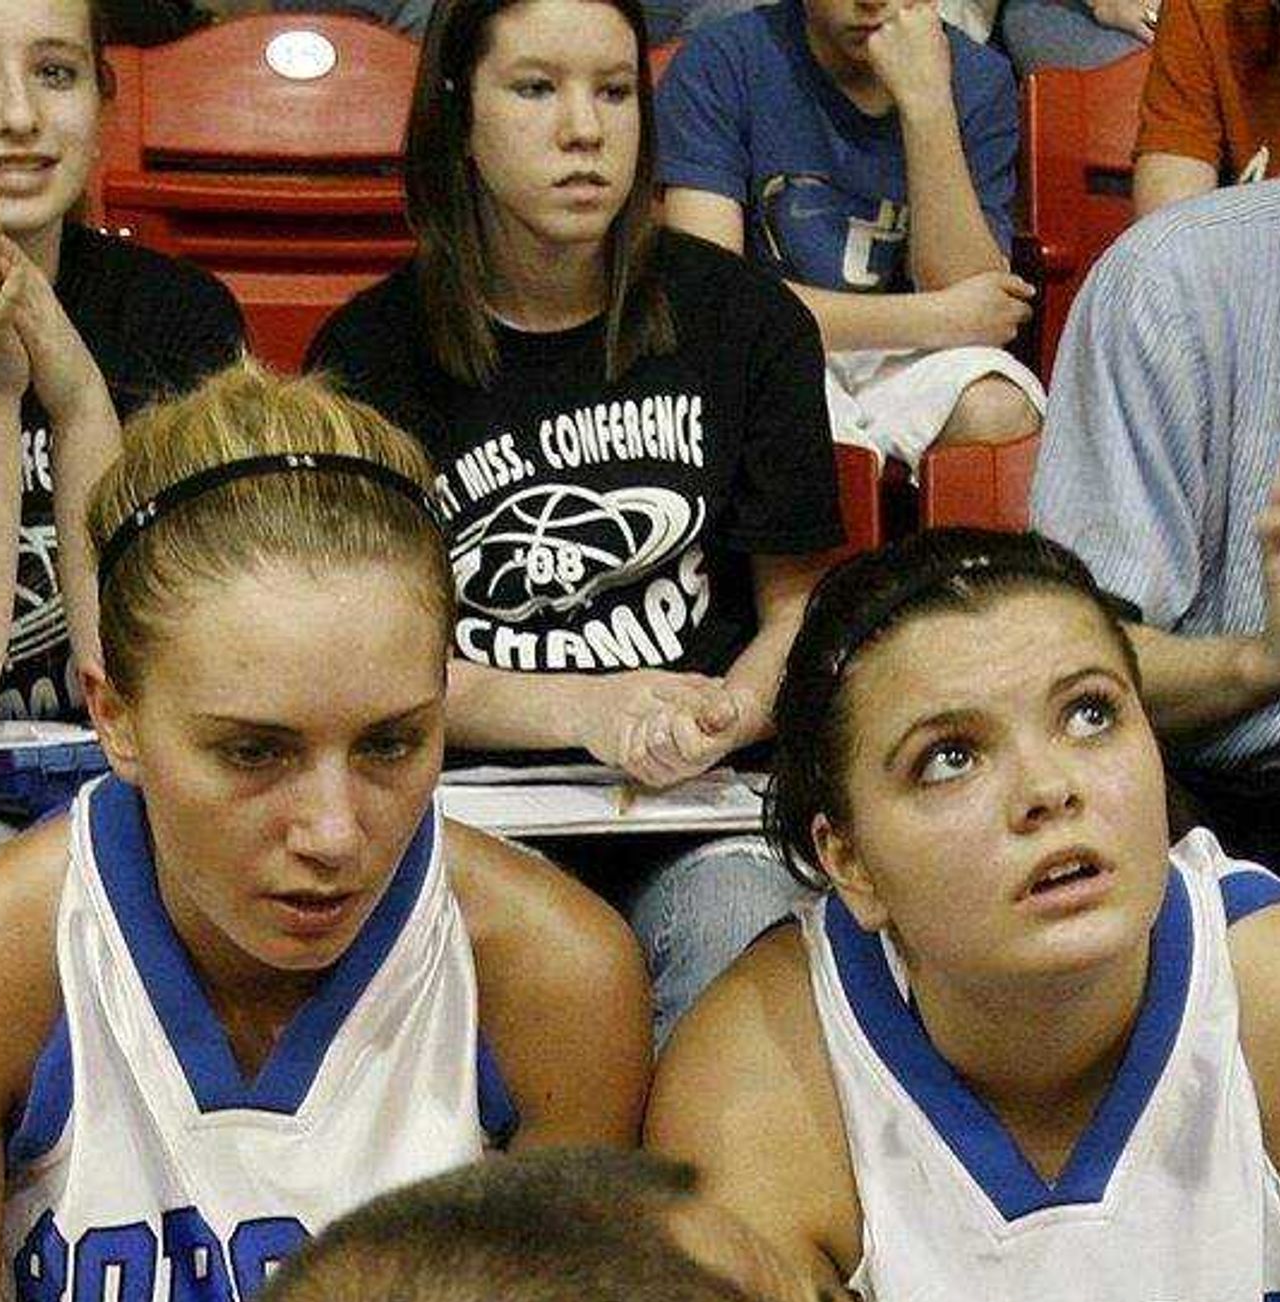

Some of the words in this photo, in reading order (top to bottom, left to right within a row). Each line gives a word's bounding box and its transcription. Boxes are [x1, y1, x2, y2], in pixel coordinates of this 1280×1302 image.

[455, 433, 536, 501] MISS.
[539, 394, 704, 469] CONFERENCE
[456, 543, 711, 670] CHAMPS
